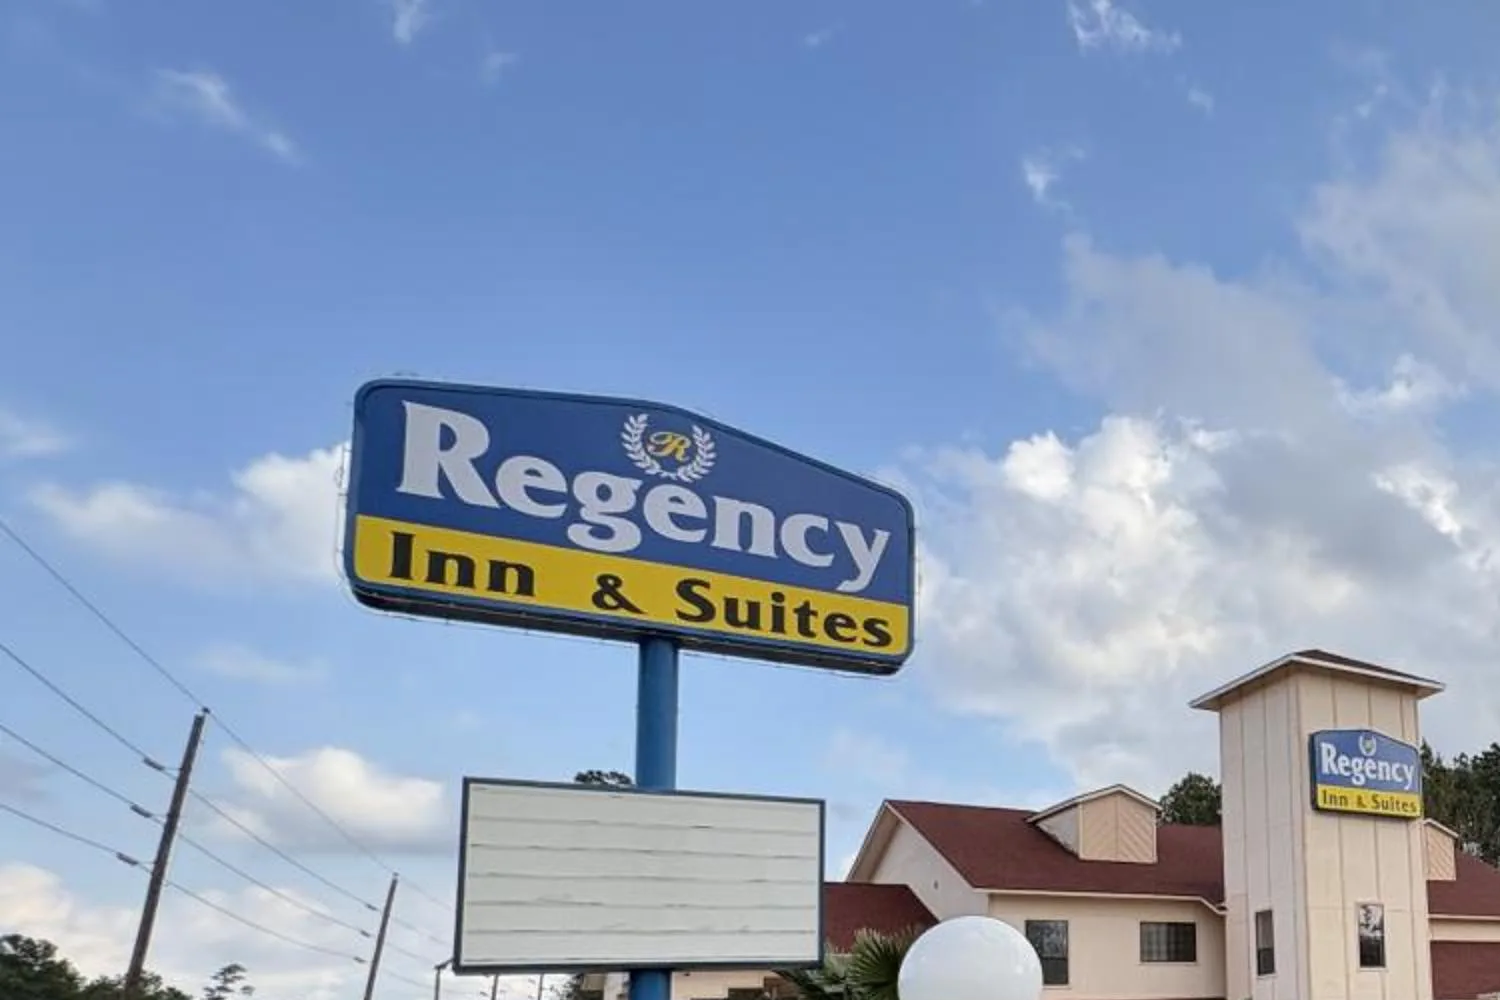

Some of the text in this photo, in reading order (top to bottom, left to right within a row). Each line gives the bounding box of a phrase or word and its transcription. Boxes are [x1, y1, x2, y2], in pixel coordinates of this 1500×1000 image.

[396, 401, 890, 592] Regency
[388, 531, 893, 648] Inn & Suites
[1320, 741, 1414, 790] Regency
[1322, 789, 1348, 806] Inn
[1371, 793, 1417, 812] Suites
